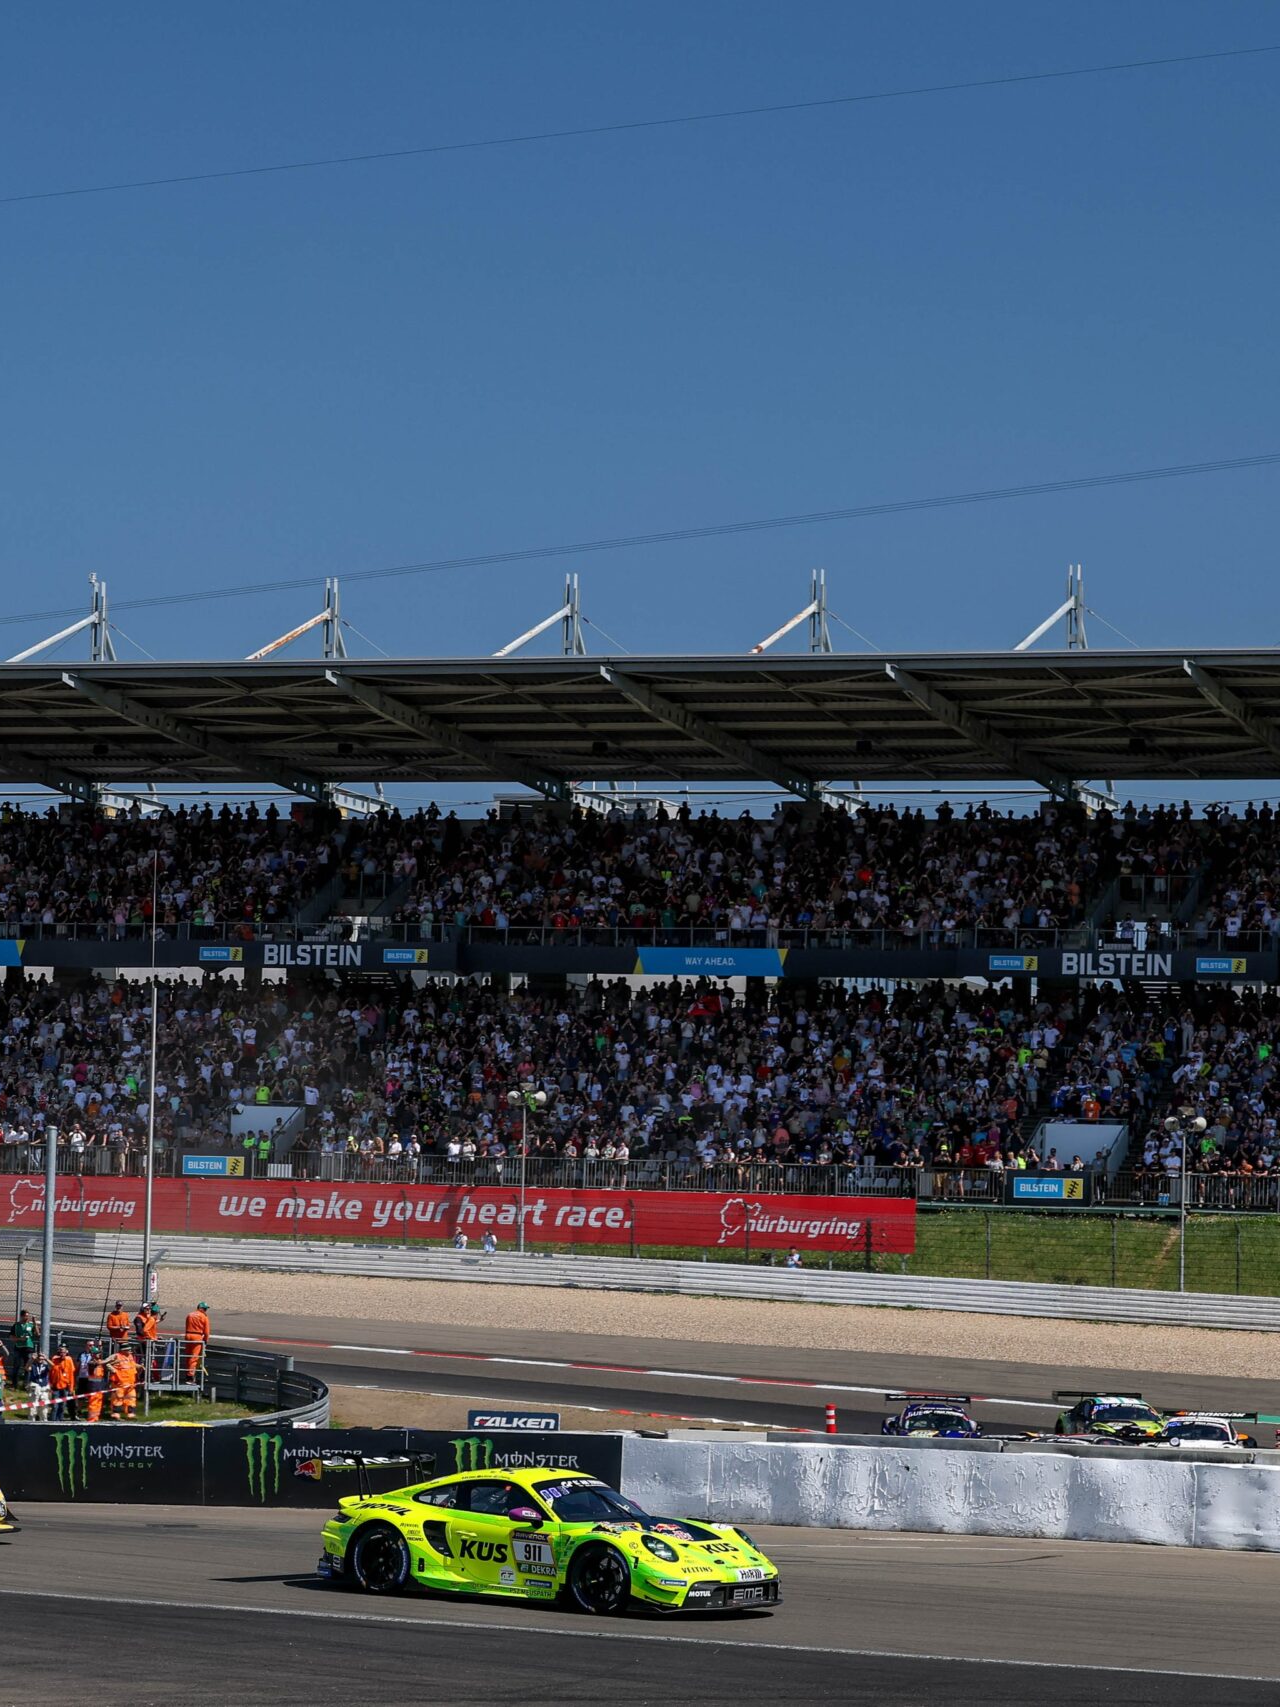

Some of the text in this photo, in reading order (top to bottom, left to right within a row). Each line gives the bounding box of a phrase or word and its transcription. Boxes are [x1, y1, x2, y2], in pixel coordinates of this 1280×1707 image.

[263, 944, 362, 966] BILSTEIN
[685, 957, 736, 966] WAY AHEAD.
[1061, 952, 1172, 977] BILSTEIN
[187, 1161, 223, 1170] BILSTEIN
[1019, 1183, 1058, 1192] BILSTEIN
[31, 1196, 136, 1217] nrburgring
[218, 1191, 633, 1229] we make your heart race.
[743, 1214, 861, 1240] nürburgring
[473, 1416, 556, 1430] FALKEN
[89, 1443, 165, 1459] MONSTER
[494, 1451, 580, 1469] MONSTER
[355, 1502, 412, 1516] MOTUL
[459, 1538, 508, 1563] KÜS
[524, 1543, 542, 1562] 911
[531, 1565, 556, 1576] DEKRA
[681, 1566, 713, 1574] VELTINS
